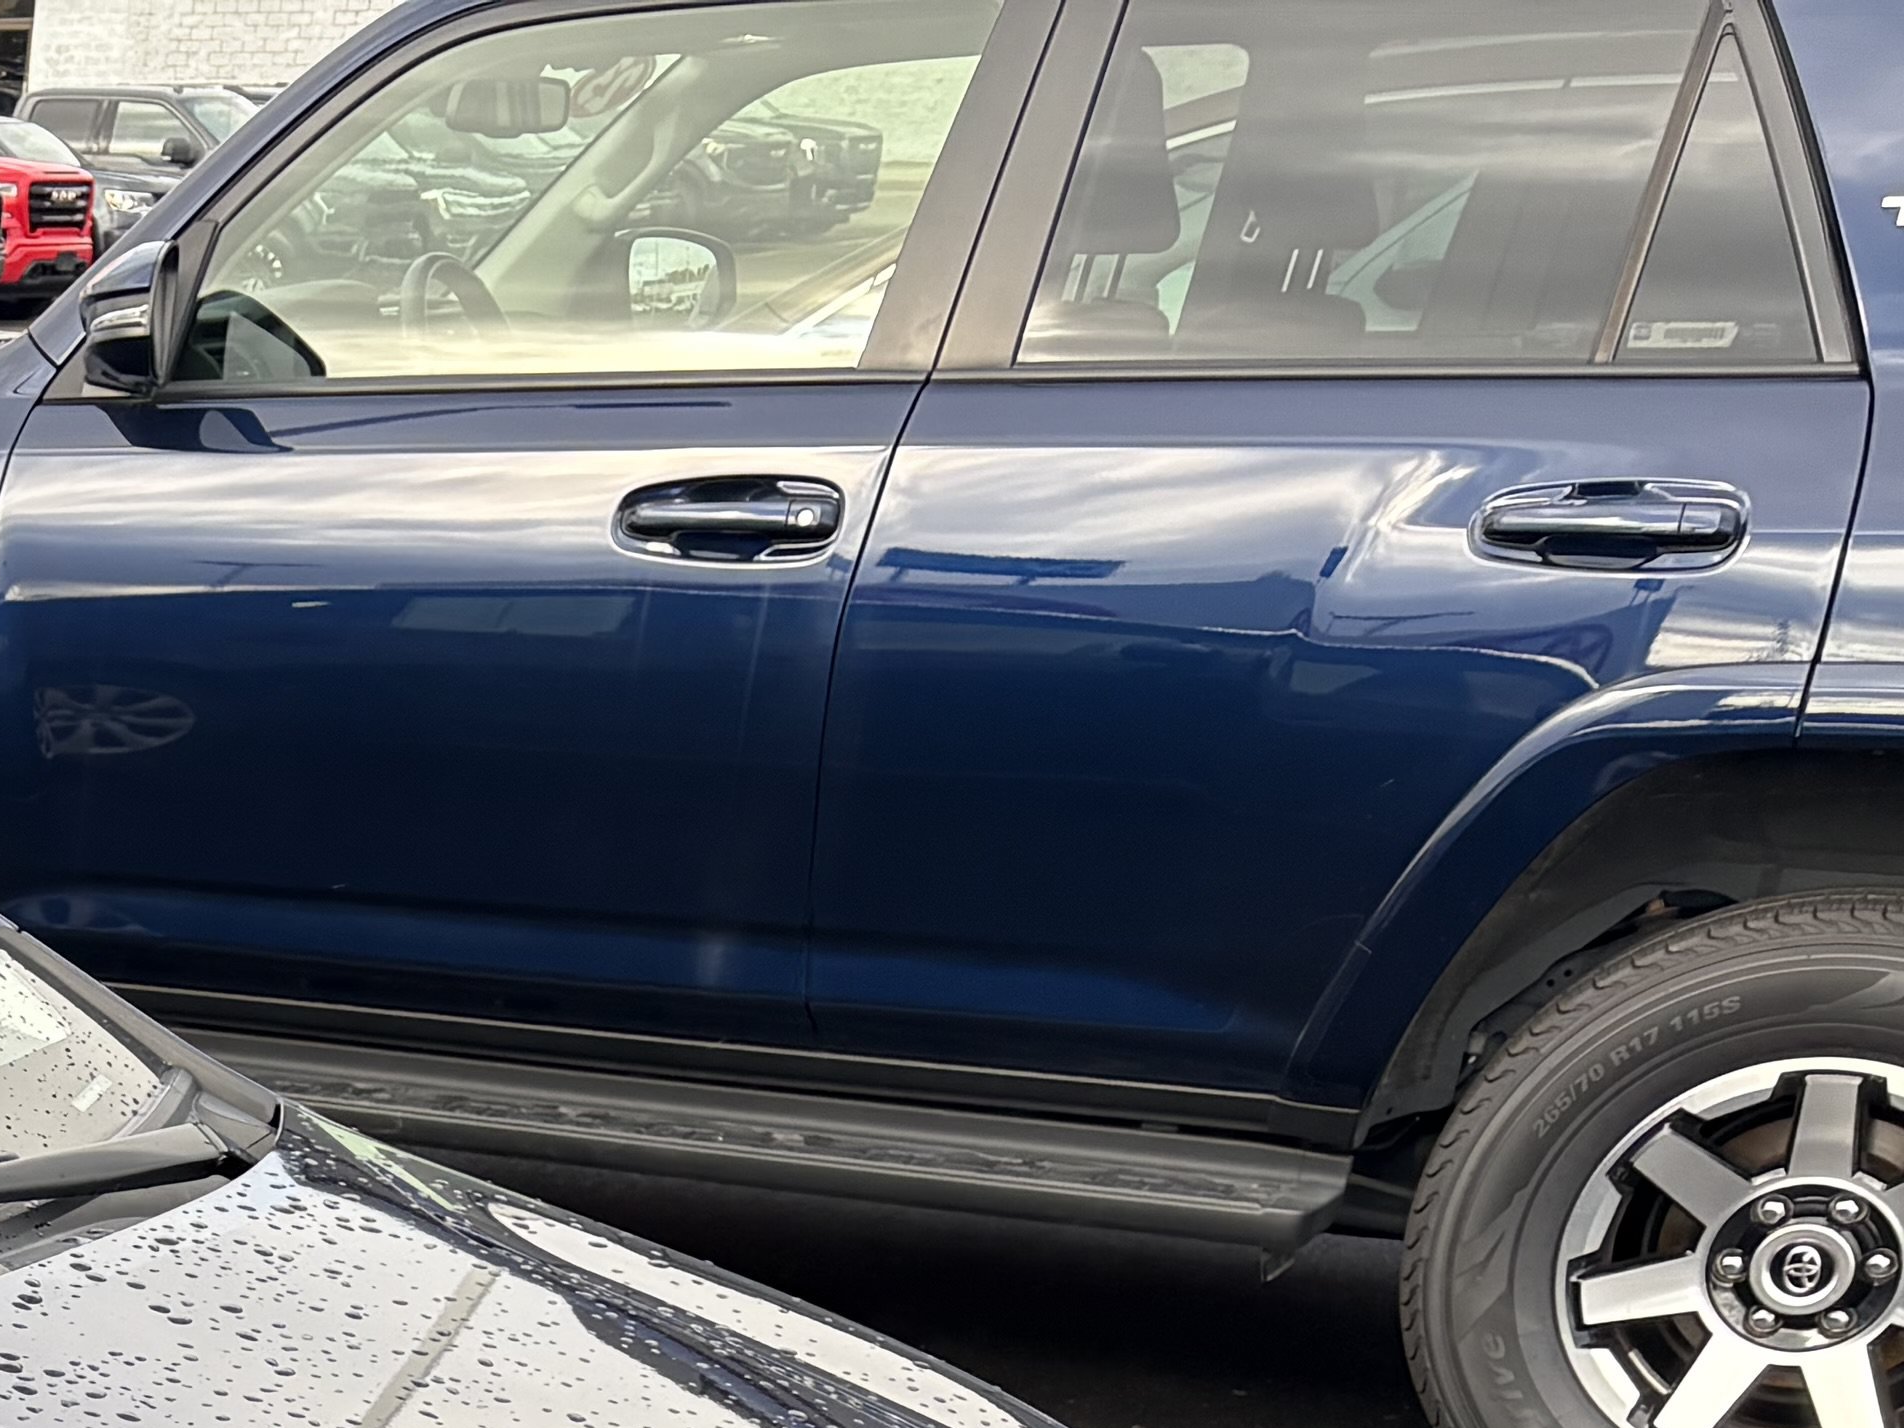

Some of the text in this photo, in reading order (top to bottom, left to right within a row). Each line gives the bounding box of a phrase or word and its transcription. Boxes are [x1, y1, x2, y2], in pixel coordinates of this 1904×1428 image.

[1533, 996, 1742, 1138] 265/70 R17 115S
